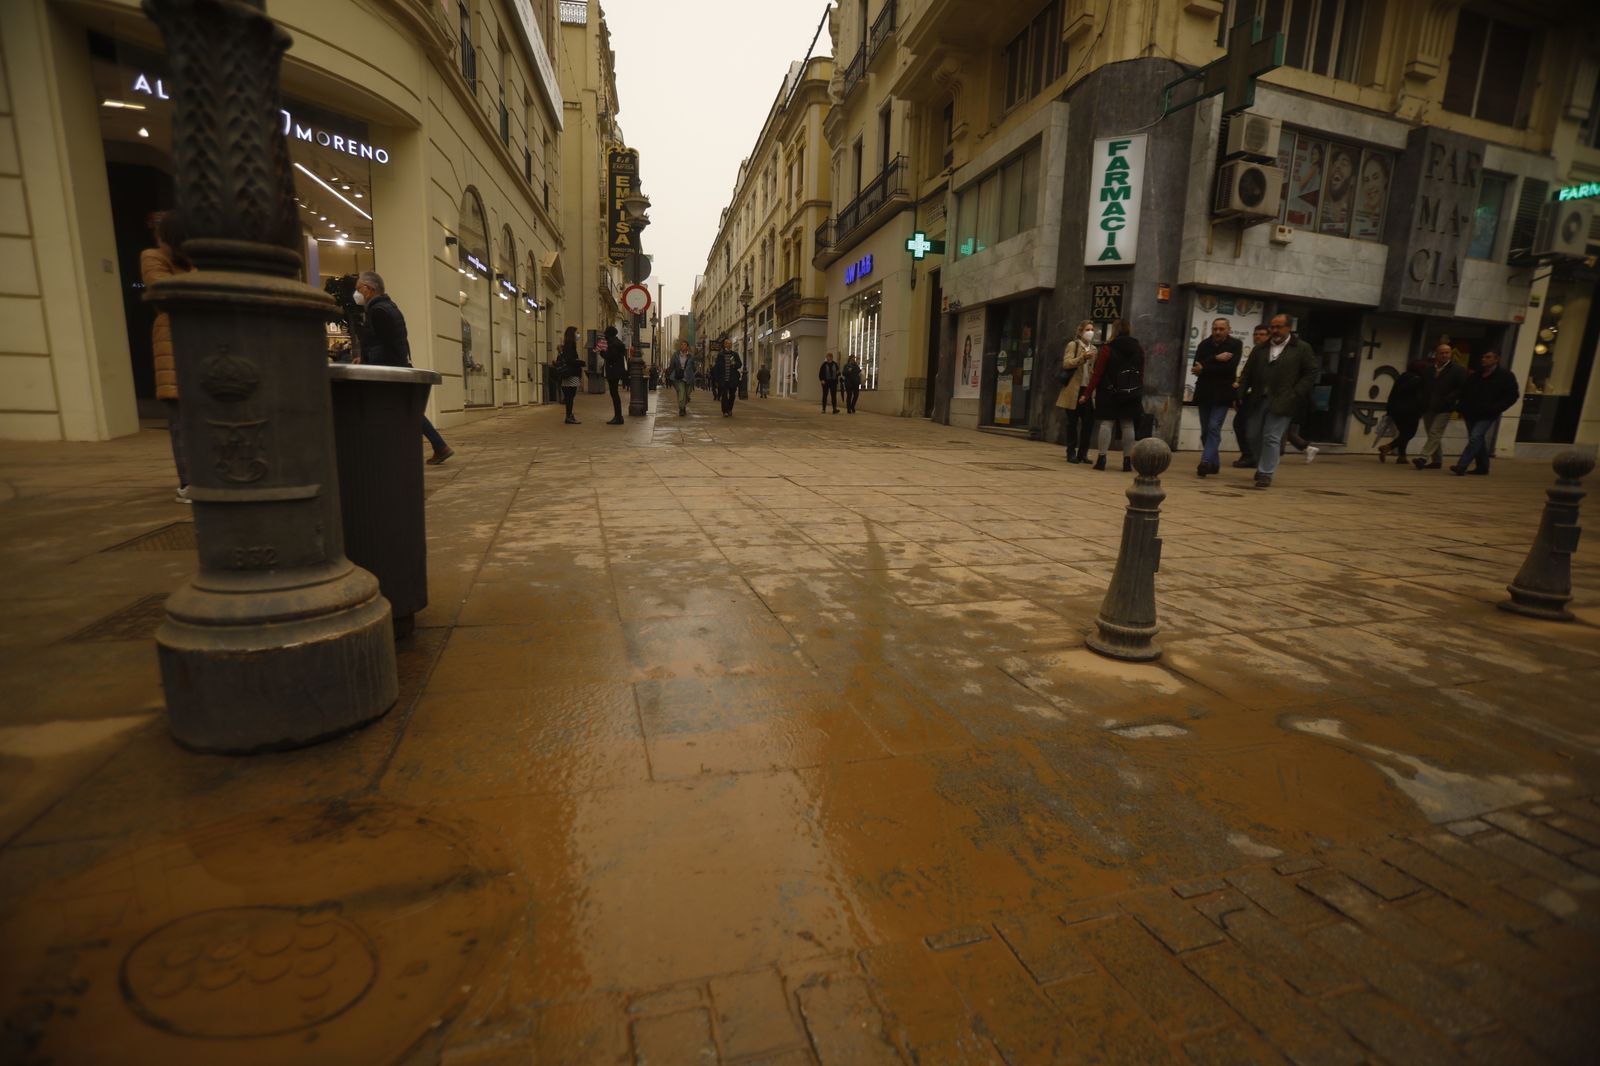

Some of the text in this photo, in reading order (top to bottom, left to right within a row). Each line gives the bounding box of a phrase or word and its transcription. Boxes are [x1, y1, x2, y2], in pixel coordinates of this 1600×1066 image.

[296, 124, 389, 164] MORENO
[1425, 141, 1482, 188] FAR
[1098, 140, 1131, 261] FARMACIA
[1409, 248, 1460, 288] CIA
[1094, 285, 1121, 297] FAR
[1094, 296, 1118, 308] MA
[1093, 307, 1121, 319] CIA
